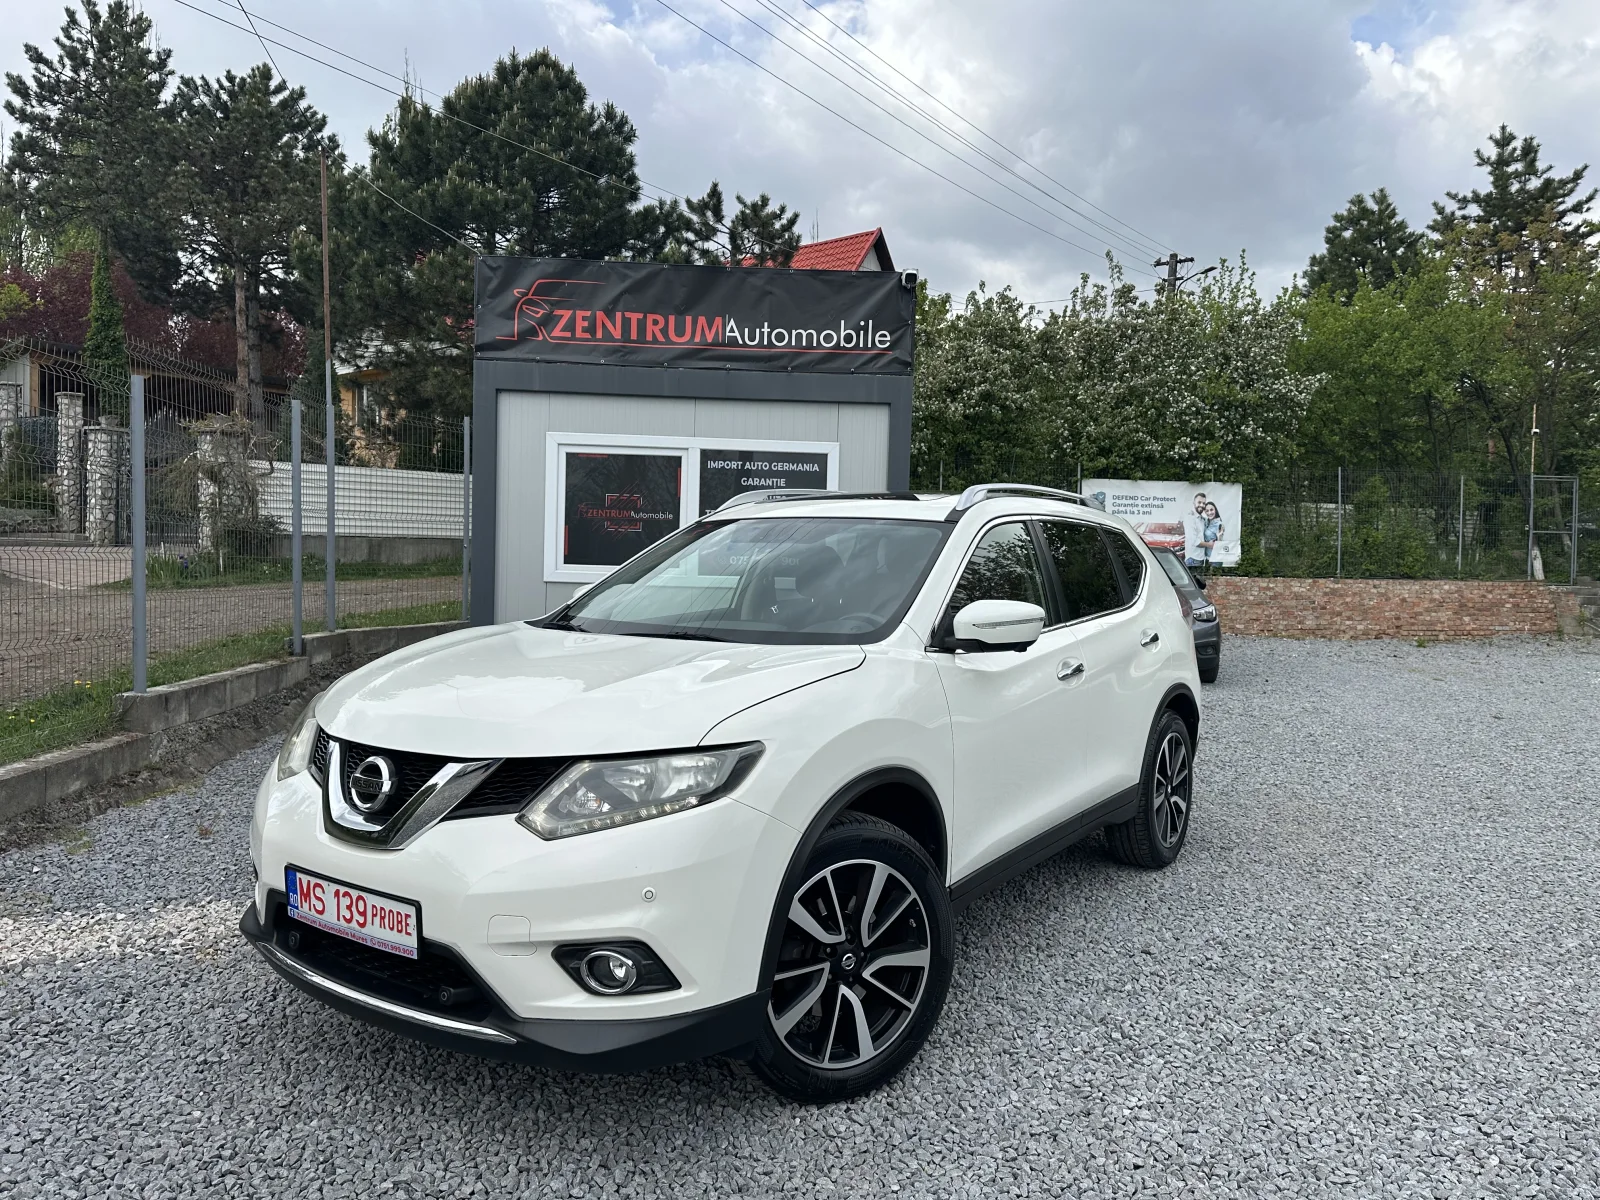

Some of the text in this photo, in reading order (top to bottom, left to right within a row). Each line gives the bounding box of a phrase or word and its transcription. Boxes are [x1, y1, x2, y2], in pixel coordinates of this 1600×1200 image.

[551, 309, 891, 348] ZENTRUM Automobile
[707, 460, 820, 472] IMPORT AUTO GERMANIA
[588, 509, 674, 519] ZENTRUM Automobile
[298, 876, 413, 937] MS 139 PROBE
[317, 921, 350, 938] Automobile
